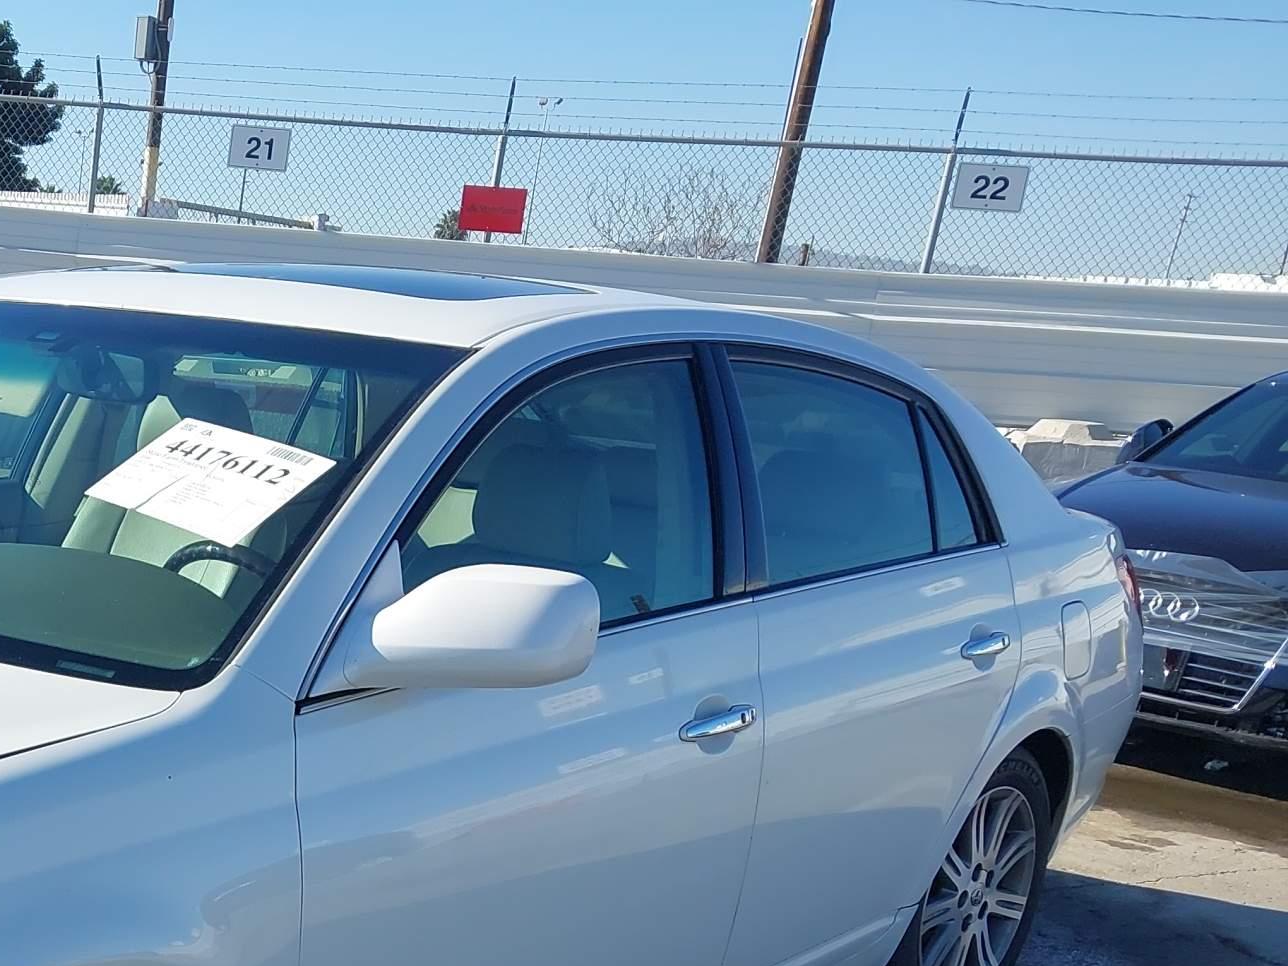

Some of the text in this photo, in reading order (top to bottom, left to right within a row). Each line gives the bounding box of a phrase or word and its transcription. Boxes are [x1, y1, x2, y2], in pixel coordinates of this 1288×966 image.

[244, 136, 274, 160] 21
[970, 175, 1010, 200] 22
[165, 440, 291, 485] 44176112
